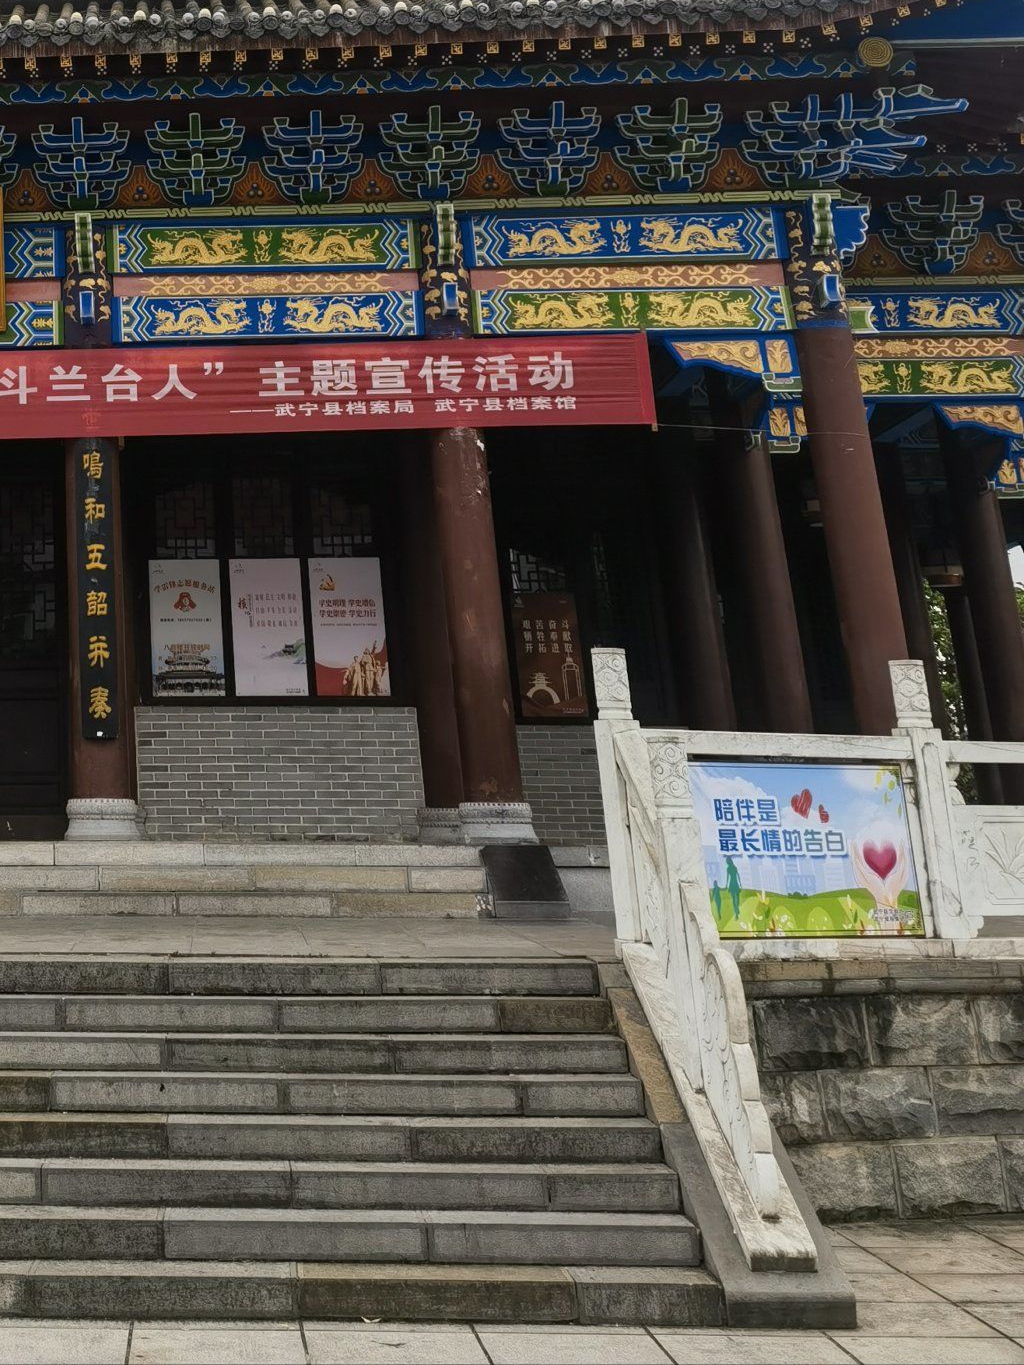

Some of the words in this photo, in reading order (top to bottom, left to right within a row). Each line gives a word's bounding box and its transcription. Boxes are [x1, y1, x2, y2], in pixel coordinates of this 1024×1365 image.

[258, 351, 575, 397] 主题宣传活动
[433, 396, 578, 413] 武宁县档案馆
[712, 798, 779, 822] 陪伴是
[717, 828, 845, 853] 最长情的告白
